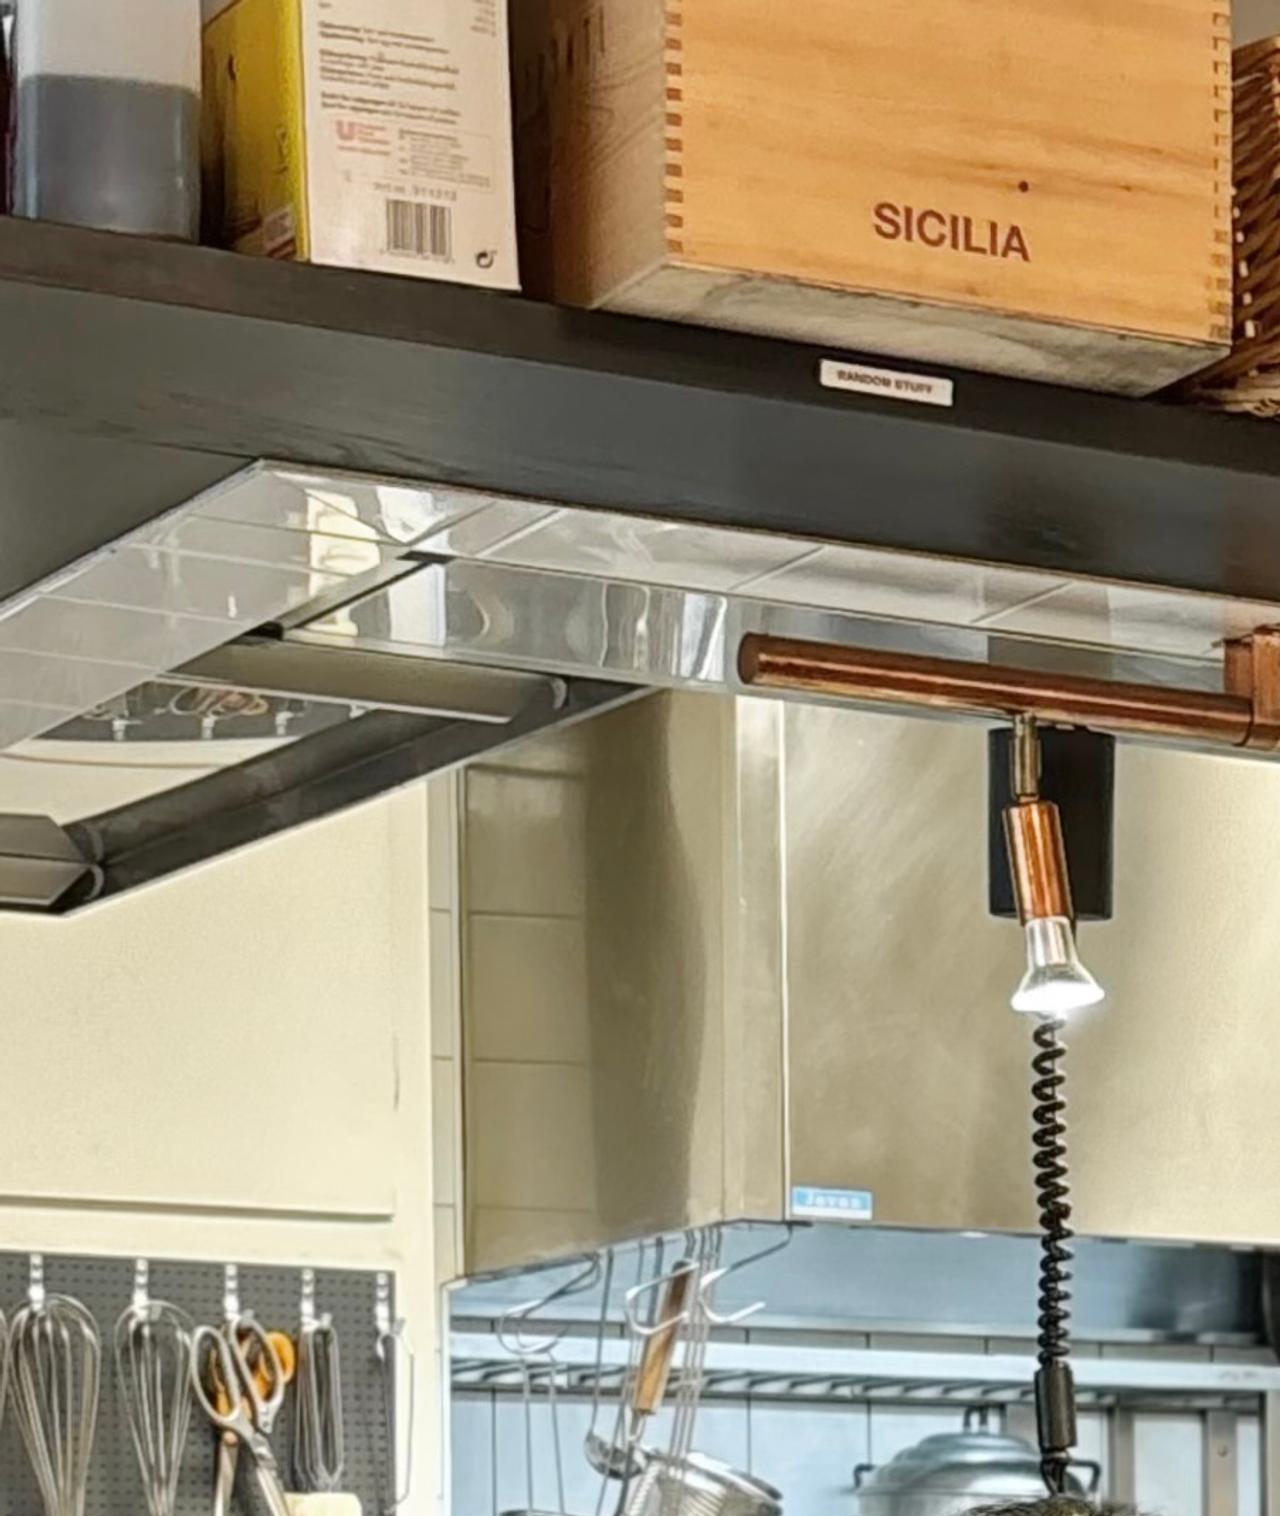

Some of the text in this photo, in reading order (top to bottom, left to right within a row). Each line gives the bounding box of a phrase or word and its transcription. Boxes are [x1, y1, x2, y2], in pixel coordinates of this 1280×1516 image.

[873, 203, 1031, 262] SICILIA
[836, 369, 933, 394] RANDOM STUFF
